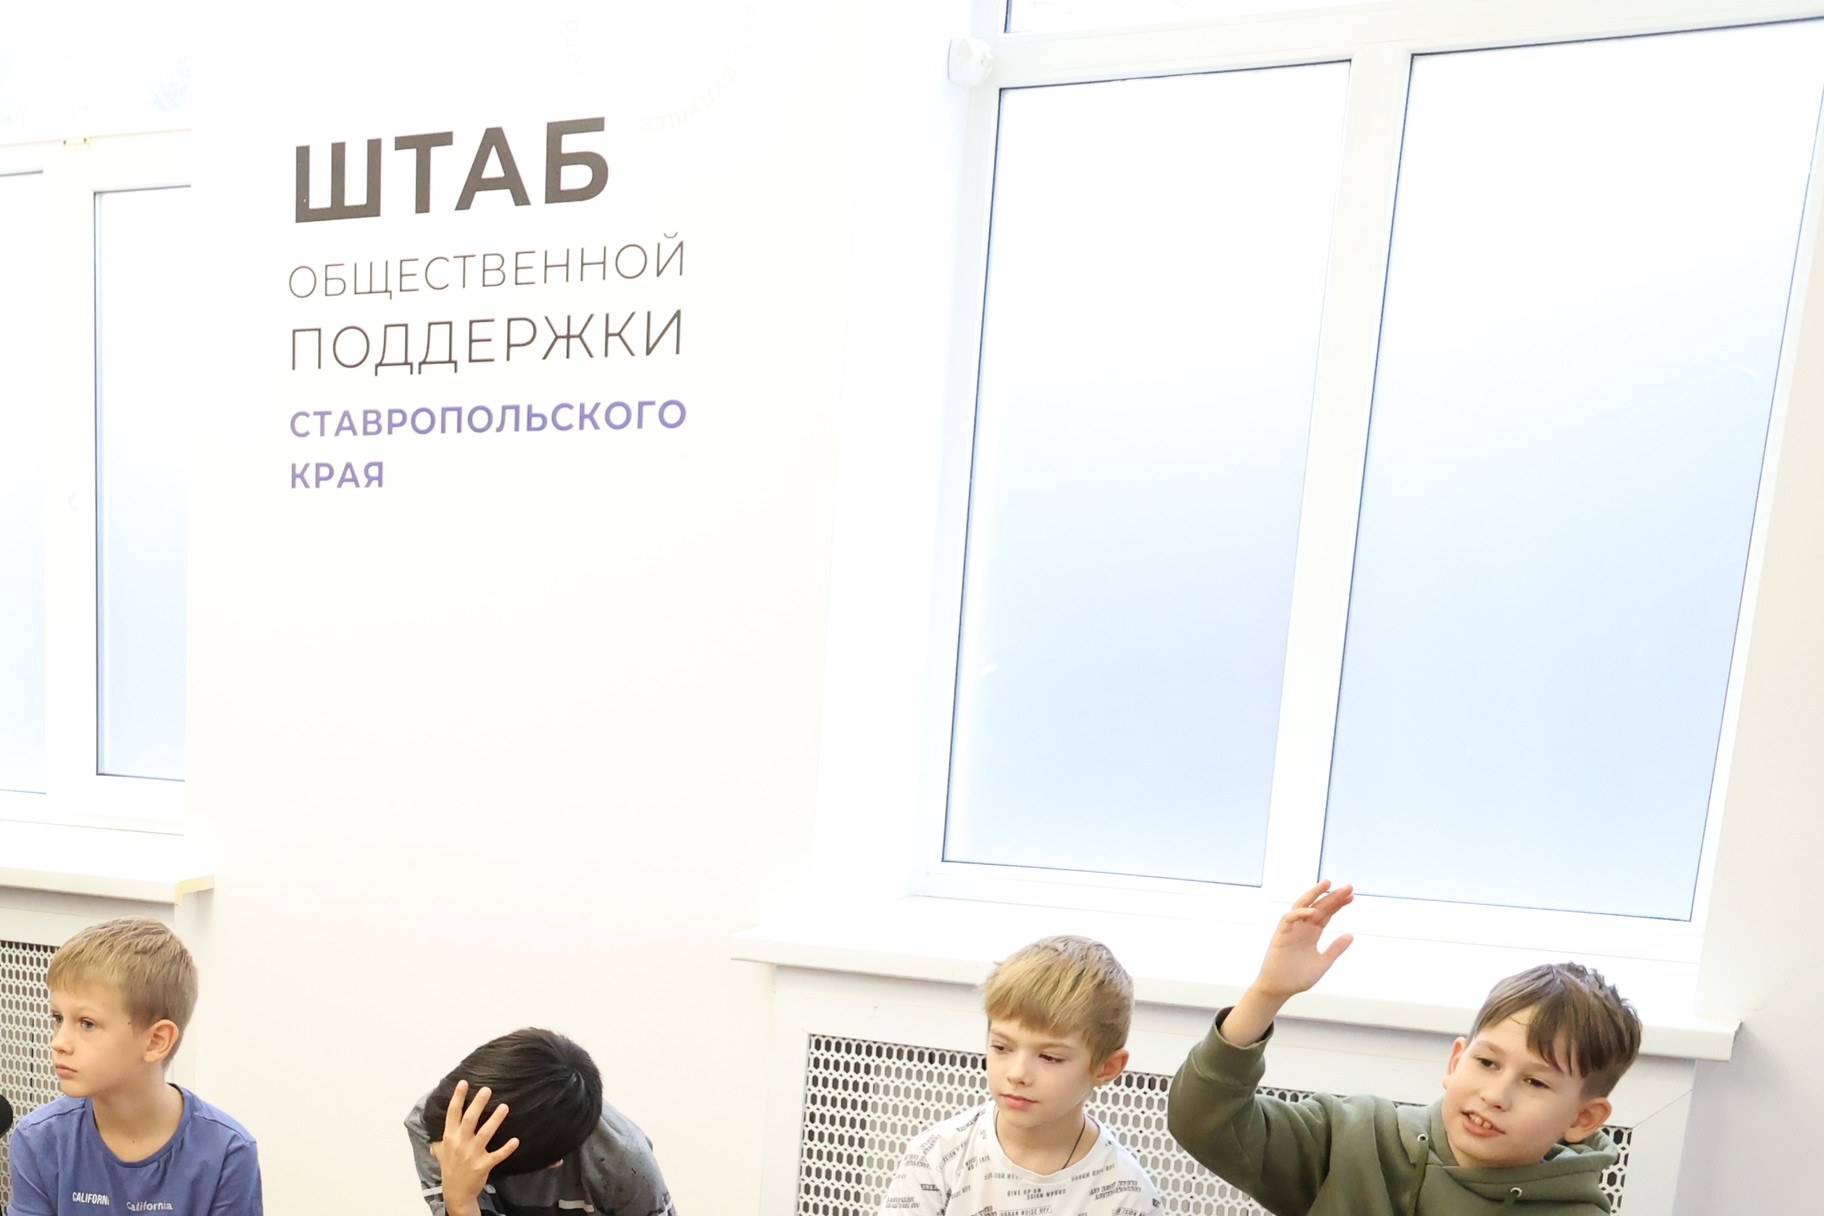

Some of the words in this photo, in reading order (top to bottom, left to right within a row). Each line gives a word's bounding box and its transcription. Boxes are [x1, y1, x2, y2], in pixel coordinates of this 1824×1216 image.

[295, 116, 609, 223] ШТАБ
[289, 231, 684, 300] ОБЩЕСТВЕННОЙ
[291, 309, 682, 377] ПОДДЕРЖКИ
[290, 399, 687, 438] СТАВРОПОЛЬСКОГО
[291, 461, 384, 489] КРАЯ
[126, 1201, 173, 1212] California
